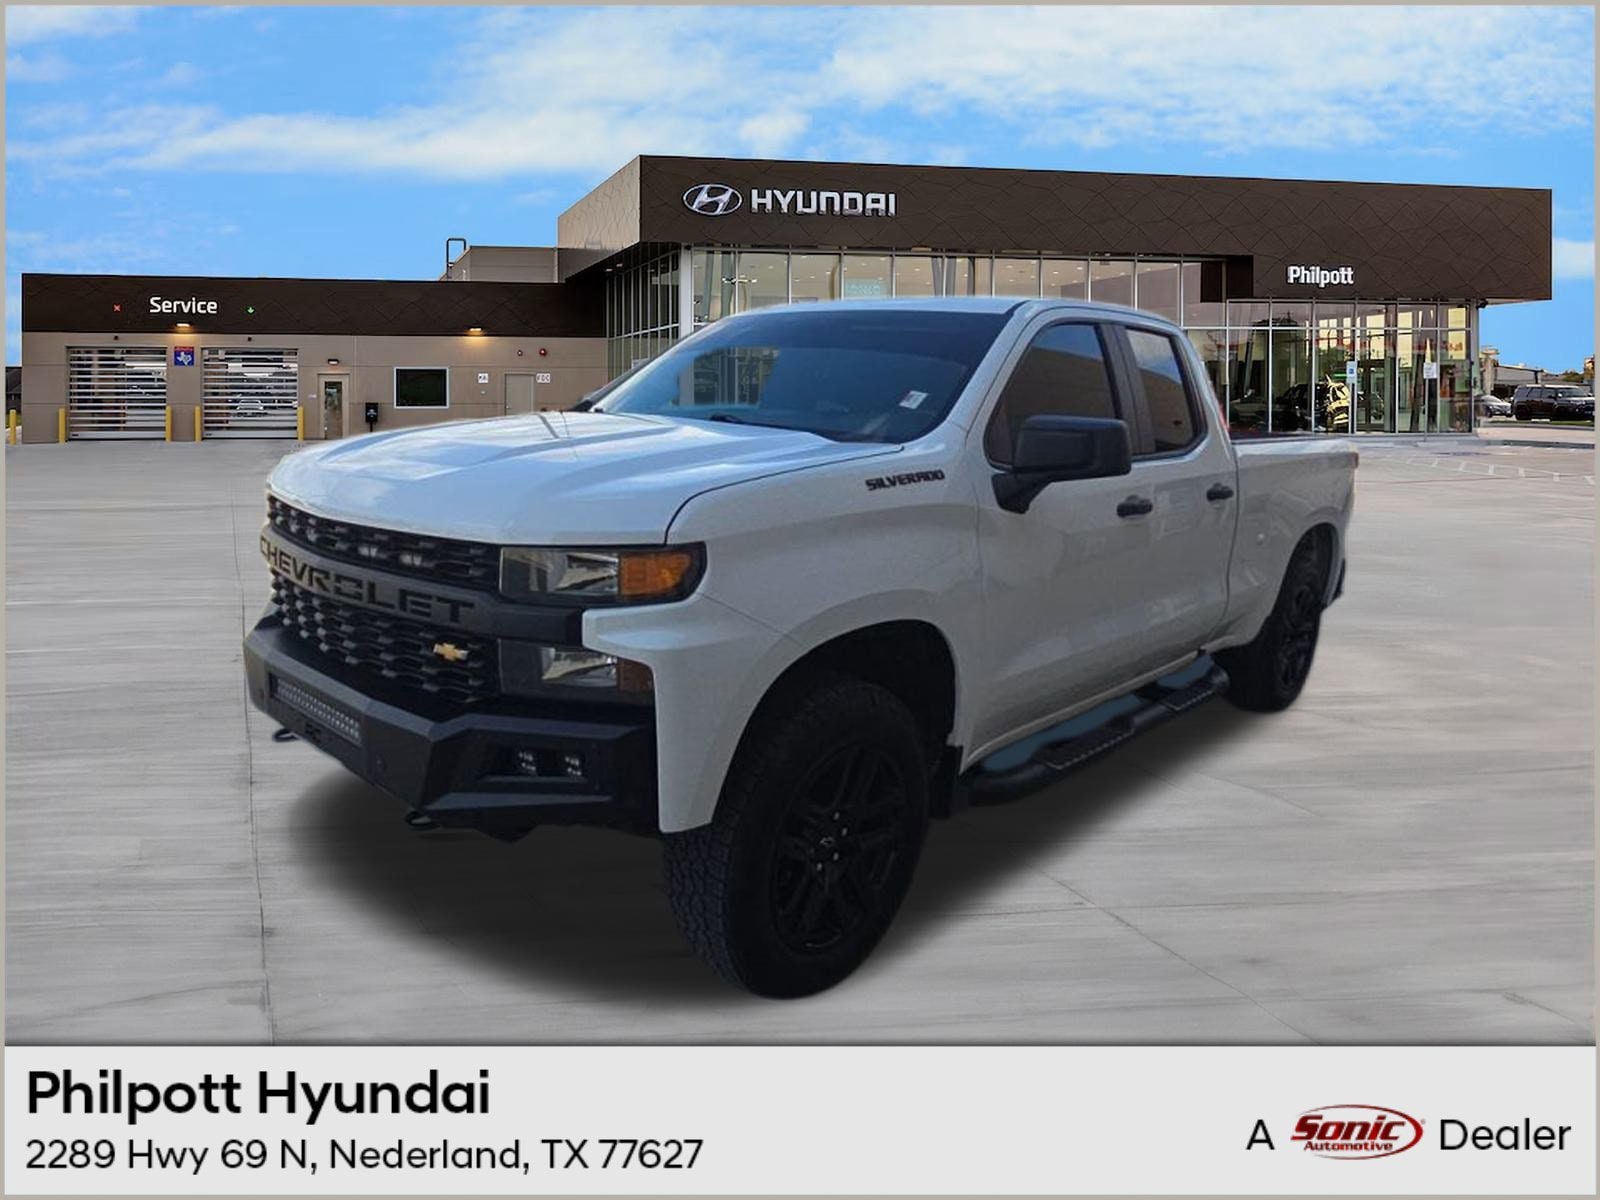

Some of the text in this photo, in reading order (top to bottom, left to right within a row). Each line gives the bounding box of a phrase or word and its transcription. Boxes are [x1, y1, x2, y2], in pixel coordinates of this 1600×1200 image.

[751, 189, 896, 216] HYUNDAI
[1287, 265, 1354, 288] Philpott
[149, 296, 218, 314] Service
[865, 469, 946, 491] SILVERADO
[259, 535, 475, 623] CHEVROLET
